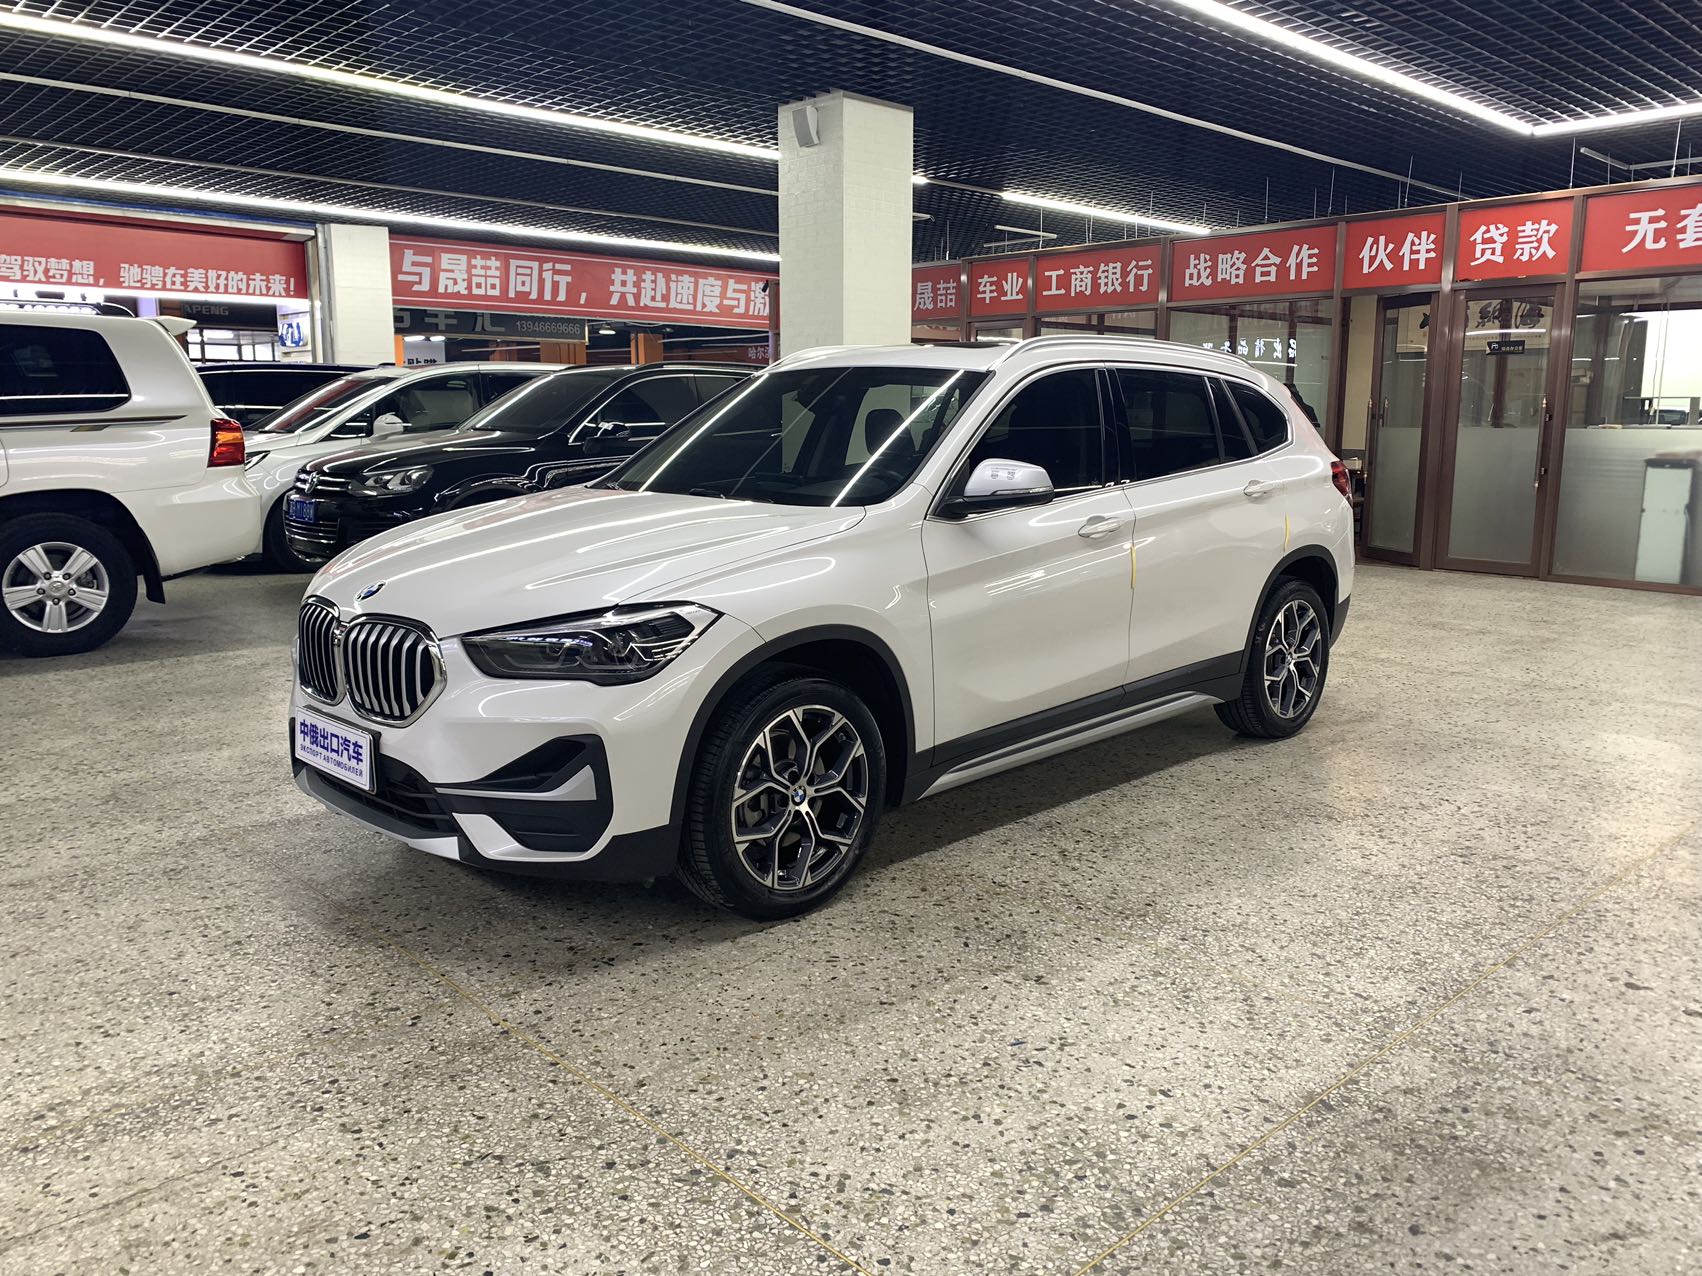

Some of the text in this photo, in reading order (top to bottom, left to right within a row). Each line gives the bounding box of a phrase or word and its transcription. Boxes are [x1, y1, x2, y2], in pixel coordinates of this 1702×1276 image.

[913, 278, 957, 311] 晟喆
[977, 272, 1024, 304] 车业
[1042, 258, 1154, 297] 工商银行
[1184, 243, 1321, 288] 战略合作
[1359, 230, 1438, 274] 伙伴
[1468, 219, 1559, 266] 贷款
[515, 320, 581, 335] 13946669666
[300, 719, 364, 765] 中俄出口汽车
